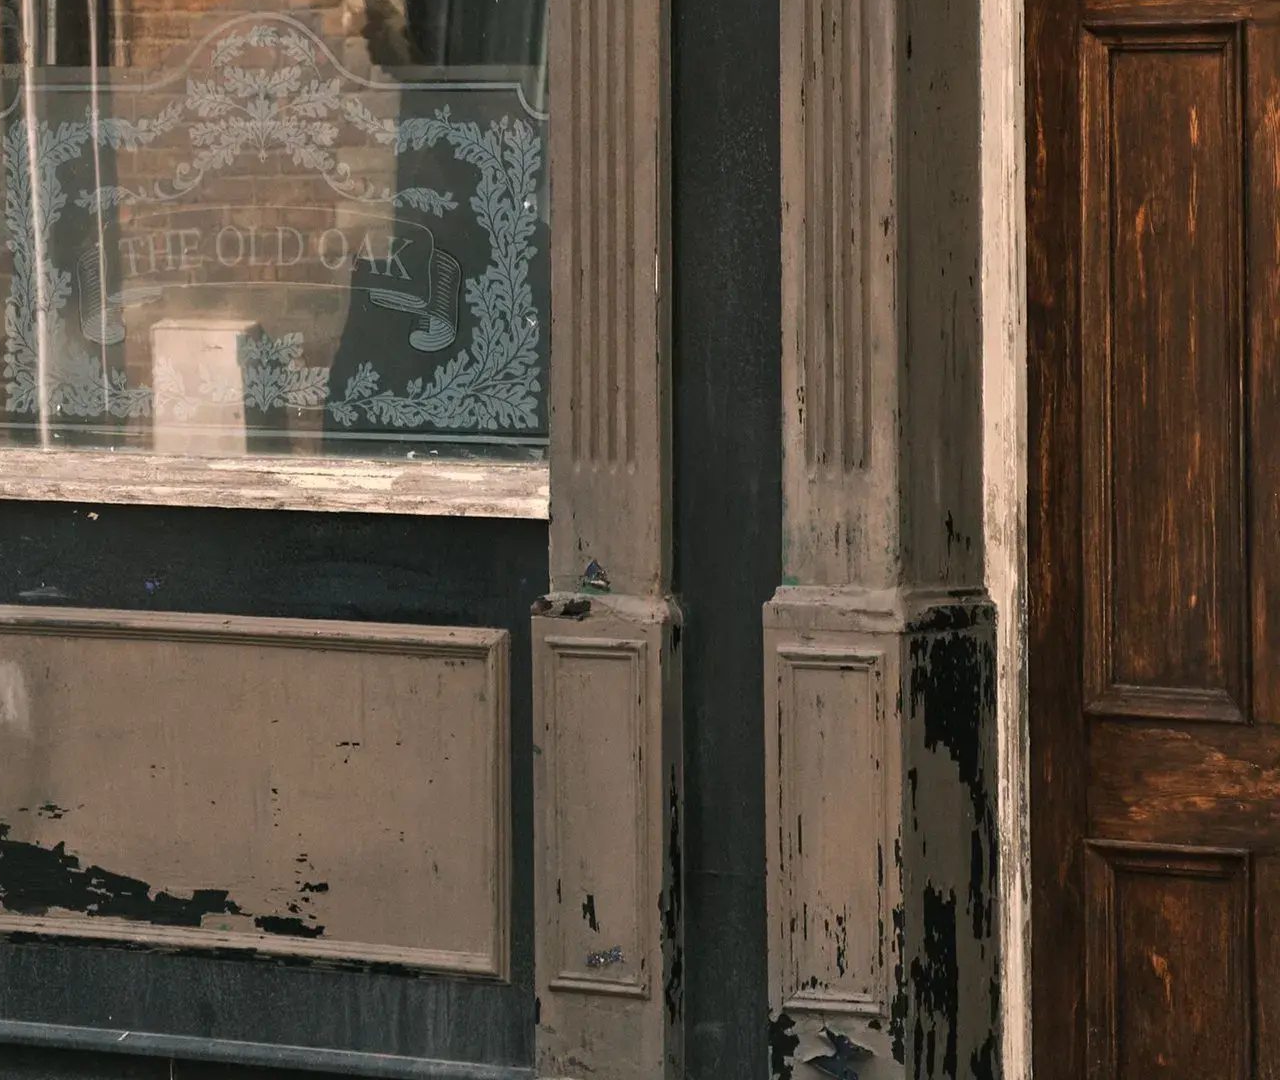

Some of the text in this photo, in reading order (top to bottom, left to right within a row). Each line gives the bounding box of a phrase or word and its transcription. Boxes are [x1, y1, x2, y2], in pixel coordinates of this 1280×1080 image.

[118, 226, 413, 282] THE OLD OAK
